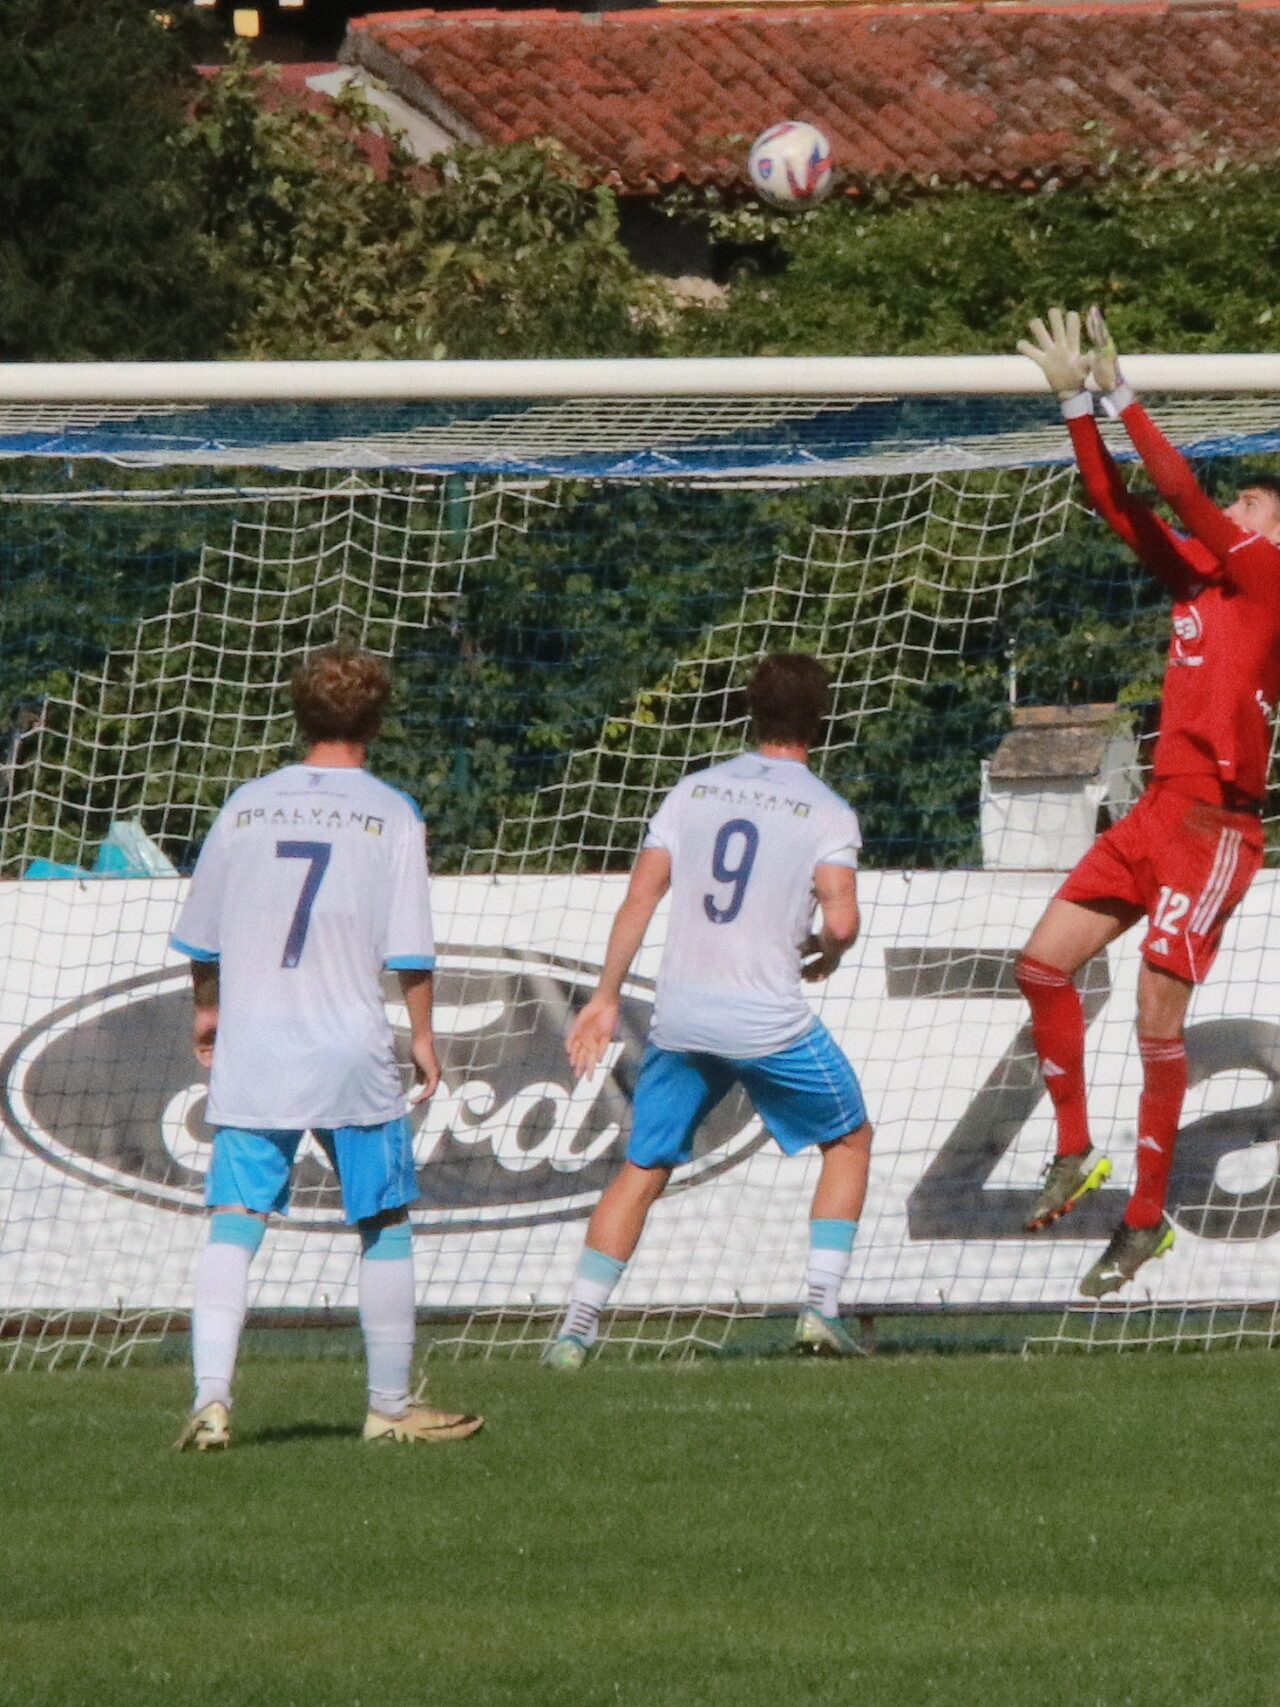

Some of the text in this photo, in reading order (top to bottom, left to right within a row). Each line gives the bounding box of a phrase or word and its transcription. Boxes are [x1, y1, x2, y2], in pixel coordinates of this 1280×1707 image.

[275, 840, 332, 968] 7
[703, 818, 760, 925] 9
[1153, 885, 1191, 936] 12
[160, 1000, 622, 1174] Frd
